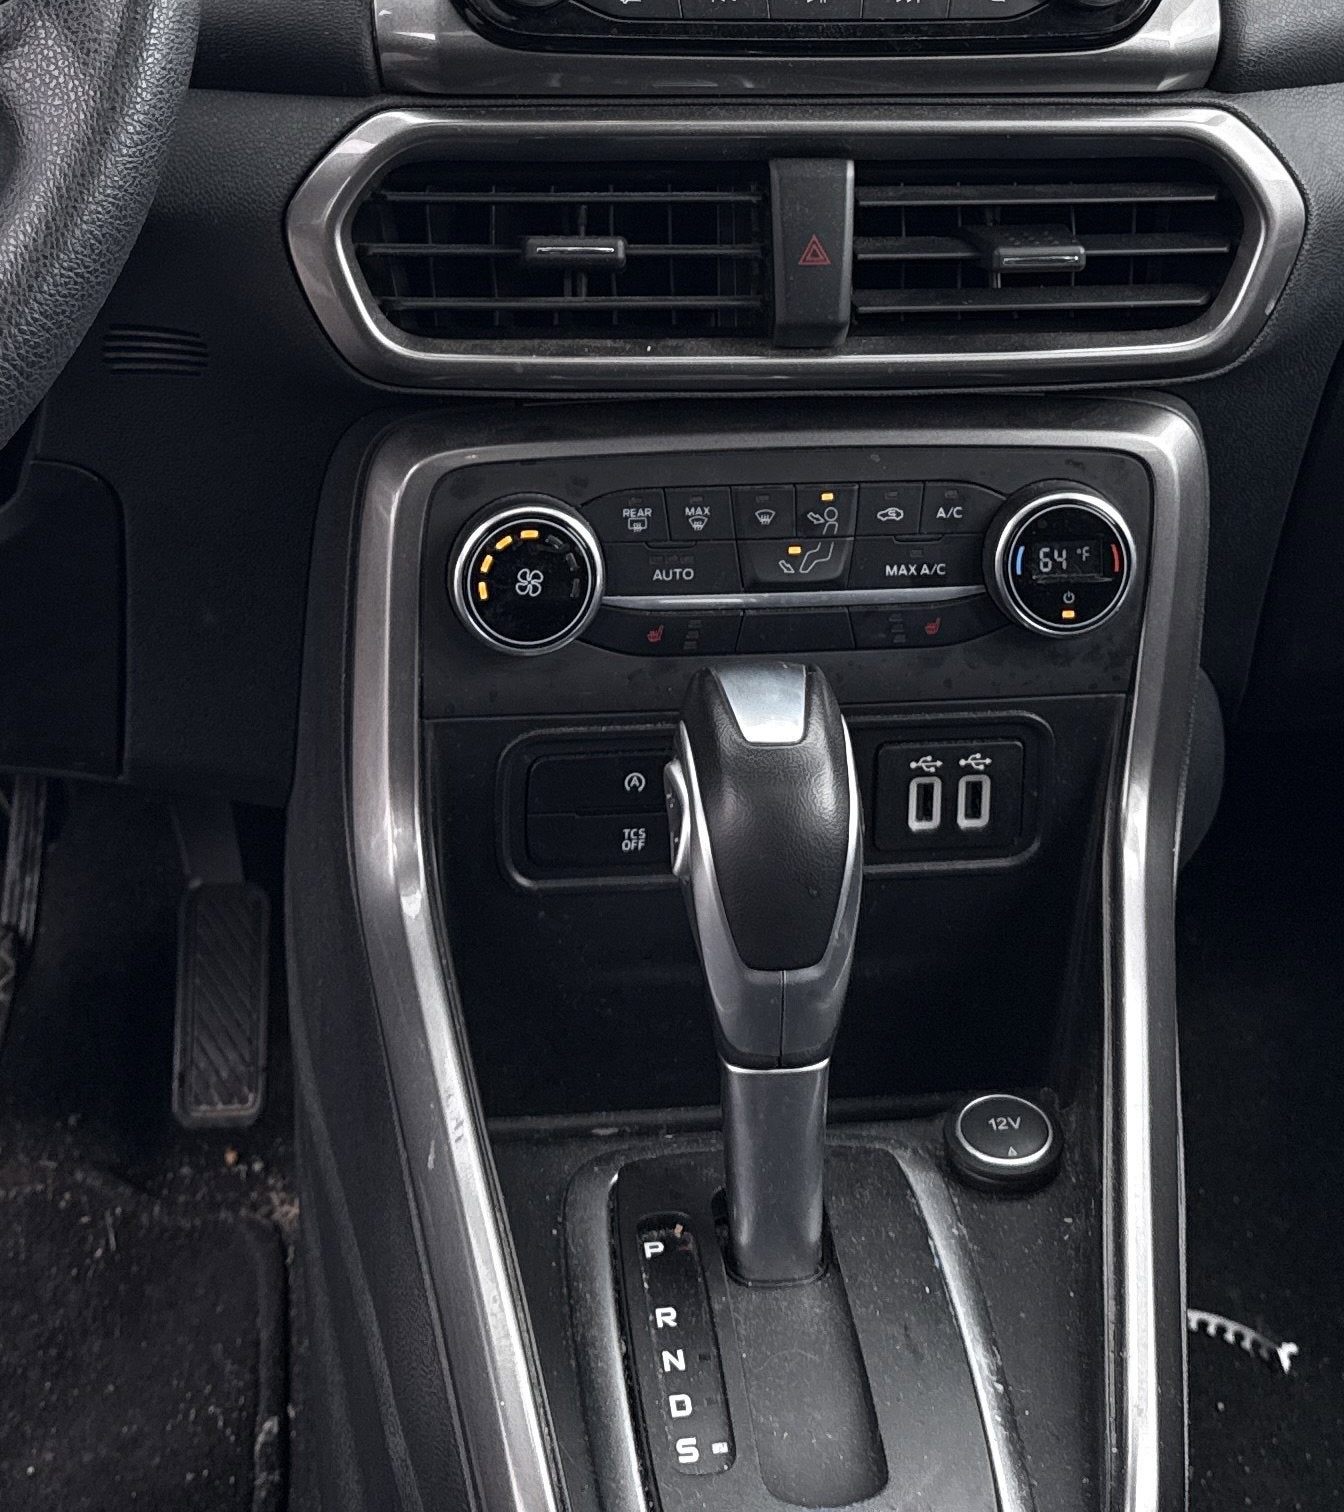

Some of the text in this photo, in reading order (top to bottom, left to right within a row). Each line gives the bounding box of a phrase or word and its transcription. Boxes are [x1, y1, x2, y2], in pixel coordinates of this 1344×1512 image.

[622, 507, 653, 519] REAR
[685, 505, 711, 517] MAX
[936, 506, 964, 520] A/C
[1039, 546, 1068, 573] 64
[652, 567, 696, 582] AUTO
[885, 562, 947, 577] MAX A/C
[622, 827, 647, 840] TCS
[621, 838, 646, 852] OFF
[987, 1115, 1022, 1131] 12V
[643, 1241, 665, 1259] P
[655, 1306, 678, 1328] R
[661, 1348, 686, 1372] N
[668, 1393, 693, 1419] D
[675, 1436, 700, 1464] S
